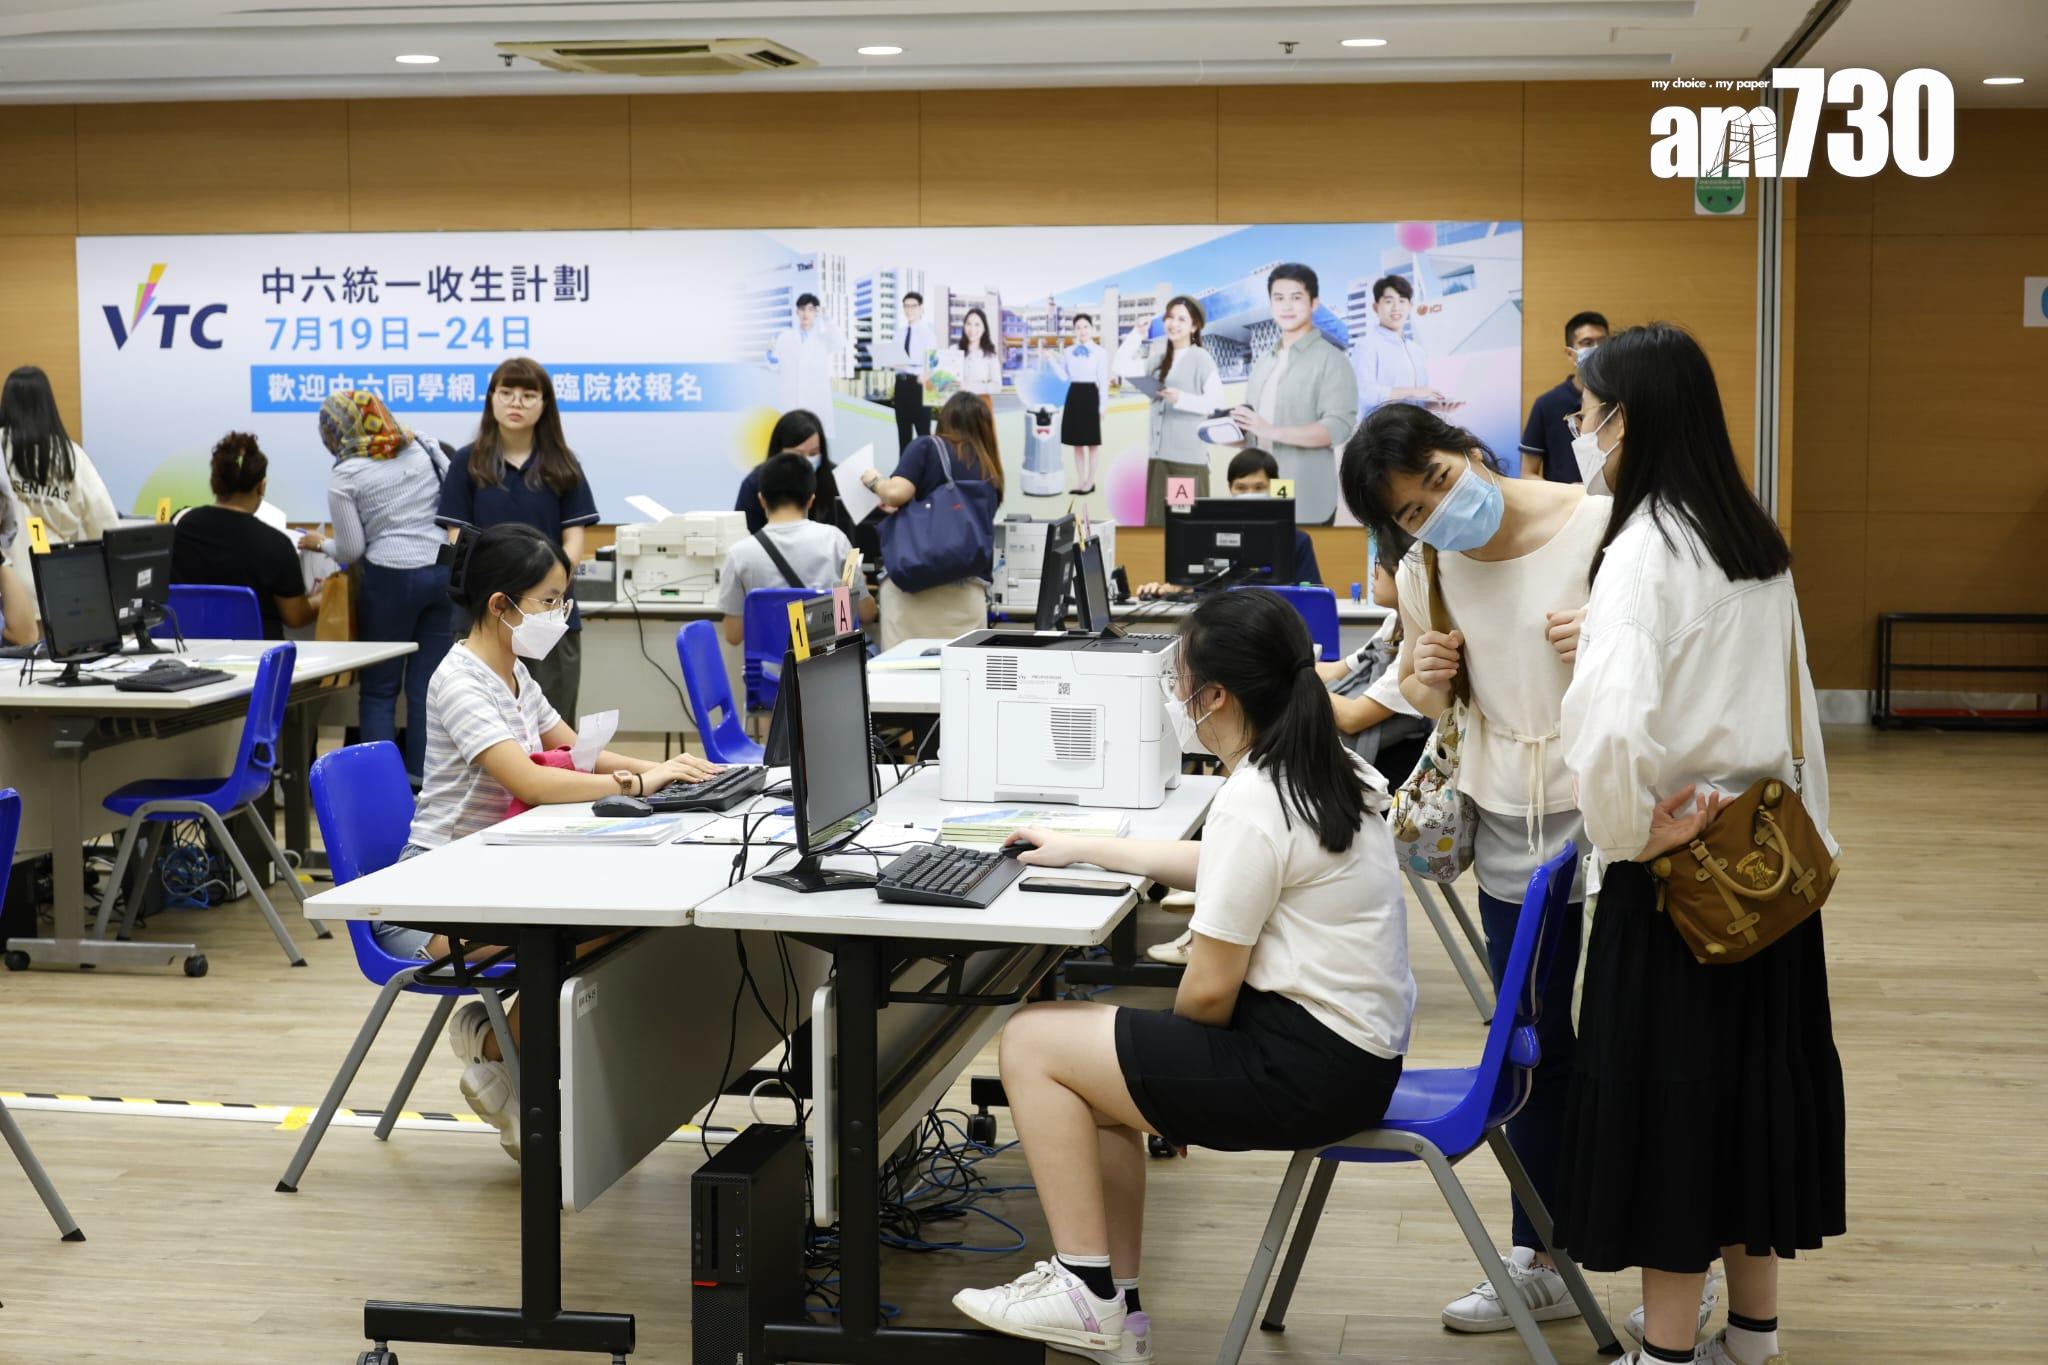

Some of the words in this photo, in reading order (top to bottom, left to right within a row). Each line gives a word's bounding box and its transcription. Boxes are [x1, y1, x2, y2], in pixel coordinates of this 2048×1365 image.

[262, 264, 591, 304] 中六統一收生計劃
[102, 263, 228, 351] VTC
[1175, 484, 1189, 499] A
[1276, 485, 1288, 499] 4
[32, 524, 41, 541] 7
[840, 599, 849, 632] A
[795, 617, 804, 648] 1
